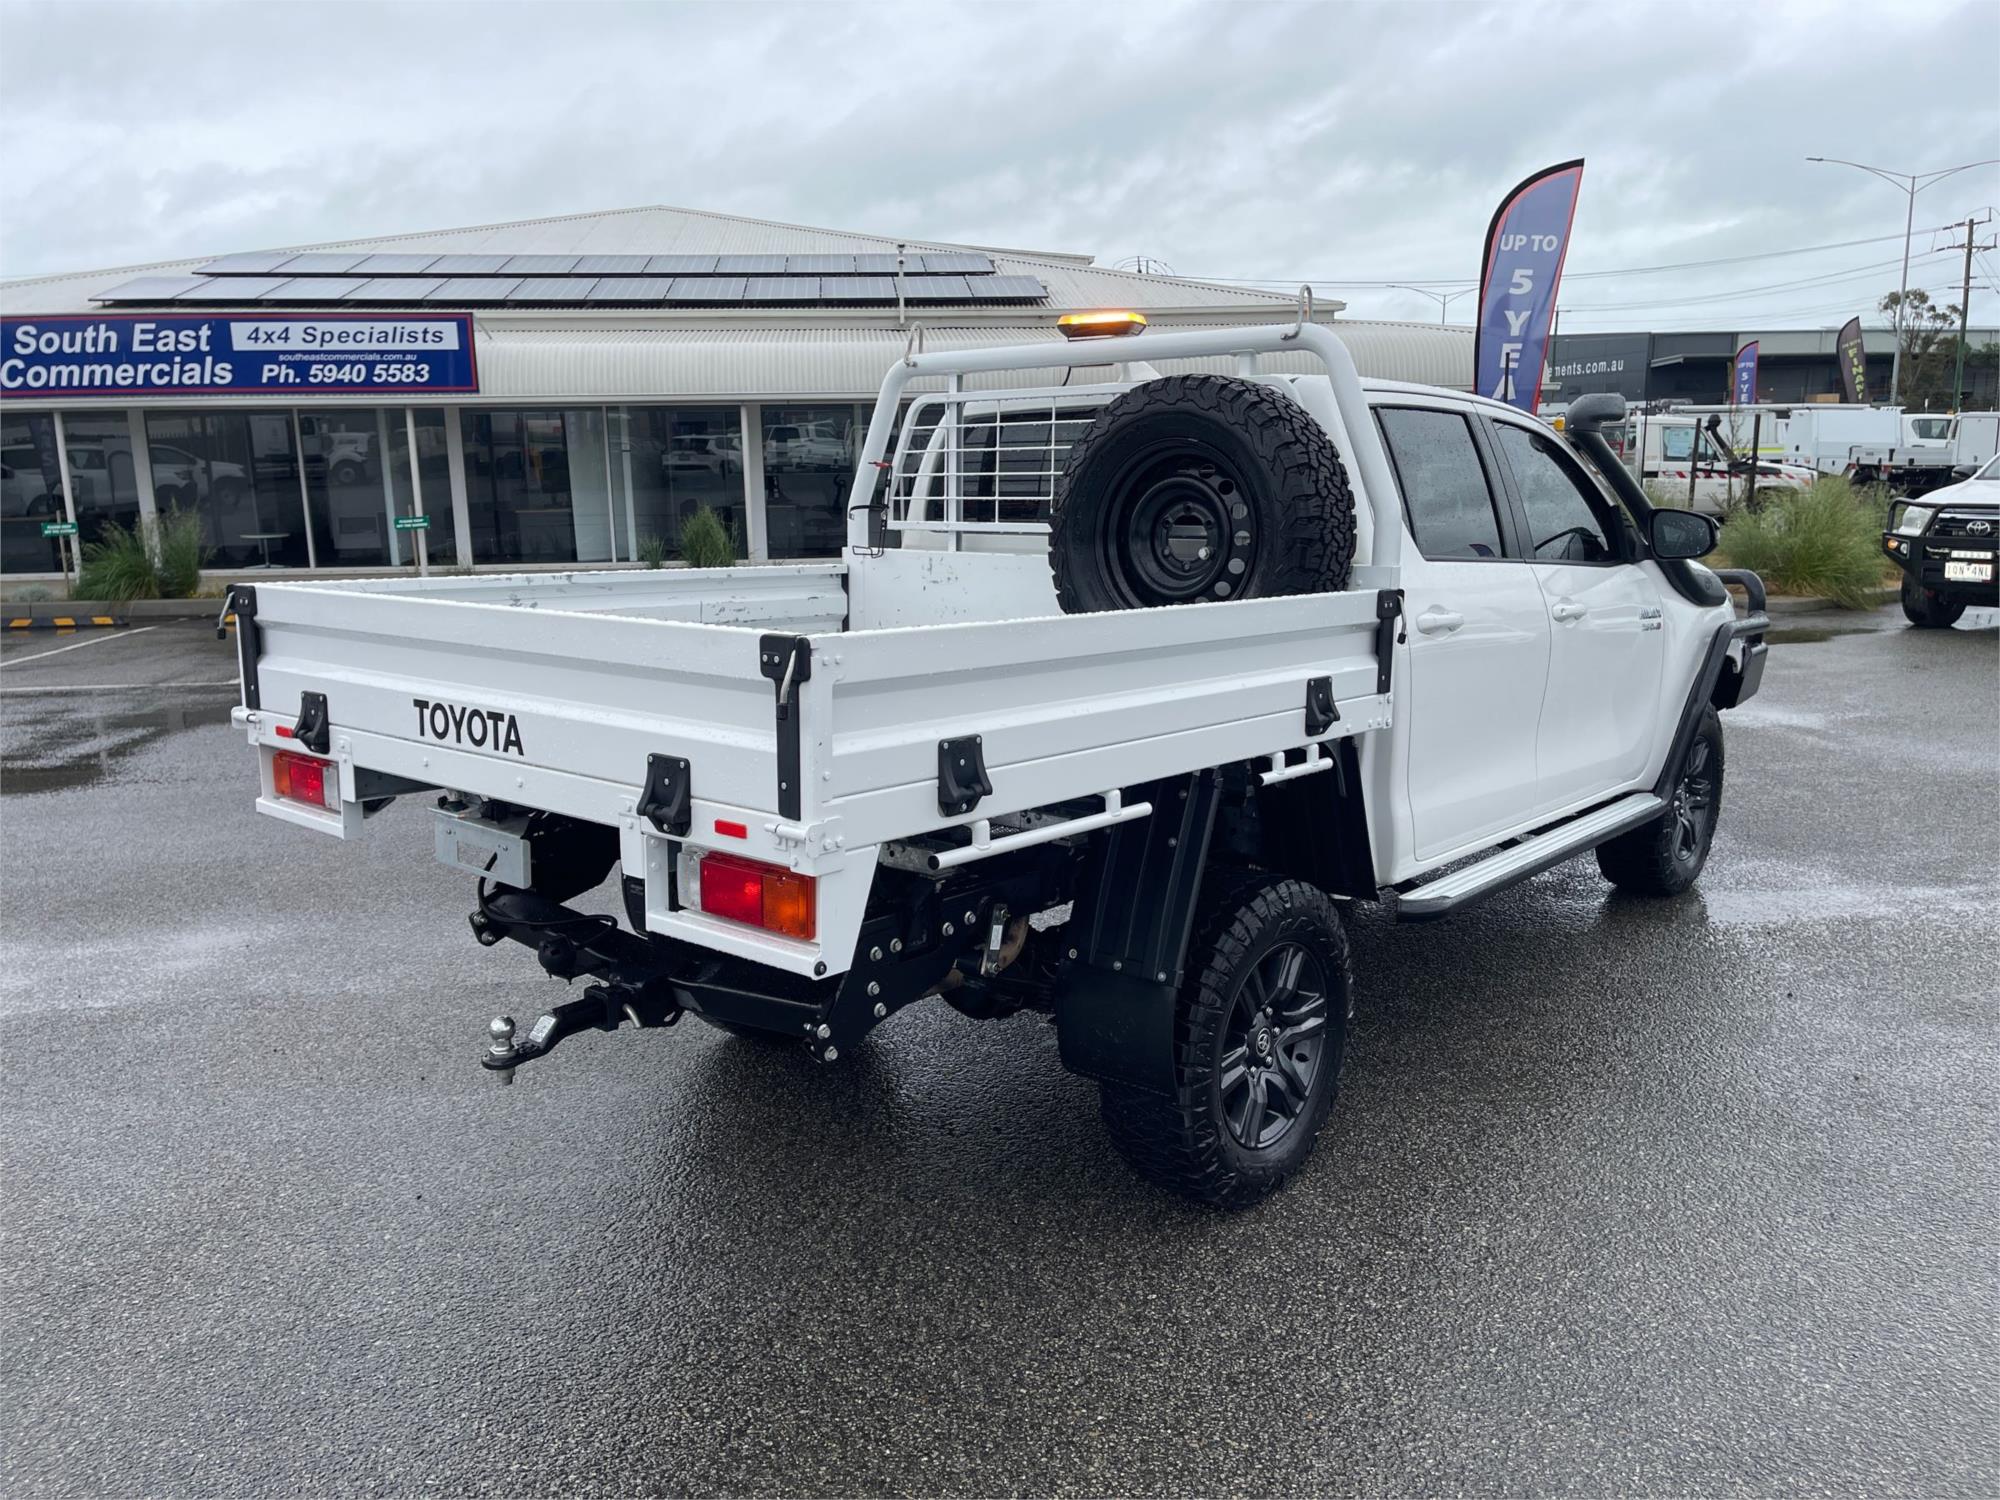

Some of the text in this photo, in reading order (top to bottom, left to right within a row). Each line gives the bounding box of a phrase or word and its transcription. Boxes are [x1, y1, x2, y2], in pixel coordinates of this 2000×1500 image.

[1500, 235, 1558, 252] UP TO
[1509, 268, 1533, 295] 5
[14, 322, 212, 355] South East
[247, 326, 444, 347] 4x4 Specialists
[278, 351, 418, 362] southeastcommercials.com.au
[0, 356, 233, 389] Commercials
[261, 363, 430, 383] Ph. 5940 5583
[413, 699, 524, 756] TOYOTA
